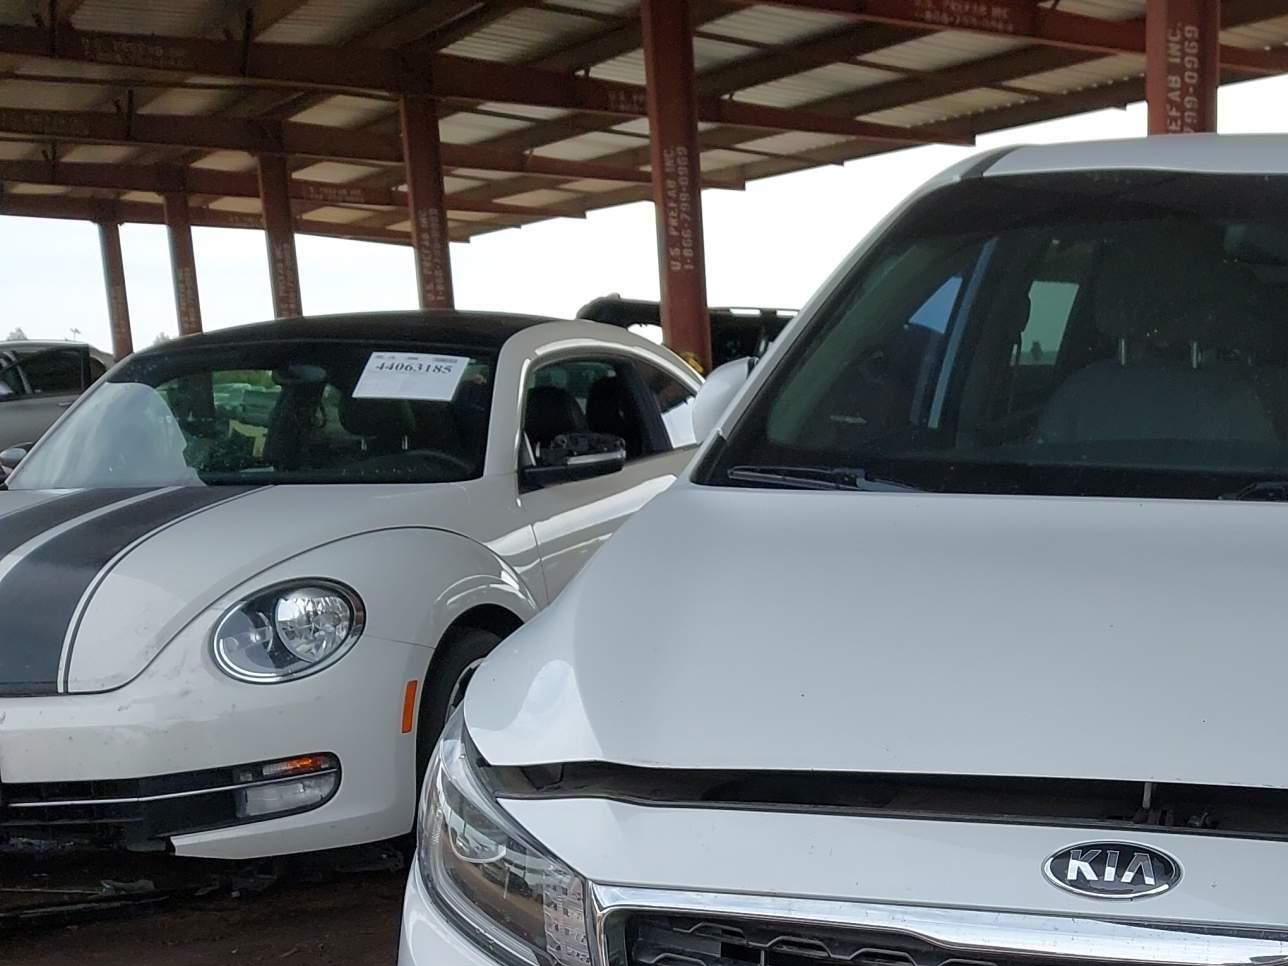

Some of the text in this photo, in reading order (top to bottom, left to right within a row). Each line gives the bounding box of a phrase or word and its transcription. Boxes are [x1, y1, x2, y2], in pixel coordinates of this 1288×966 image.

[1166, 22, 1182, 133] EFAB INC.
[666, 179, 680, 236] PREFAB
[376, 362, 452, 374] 44063185
[1066, 850, 1155, 885] KIA
